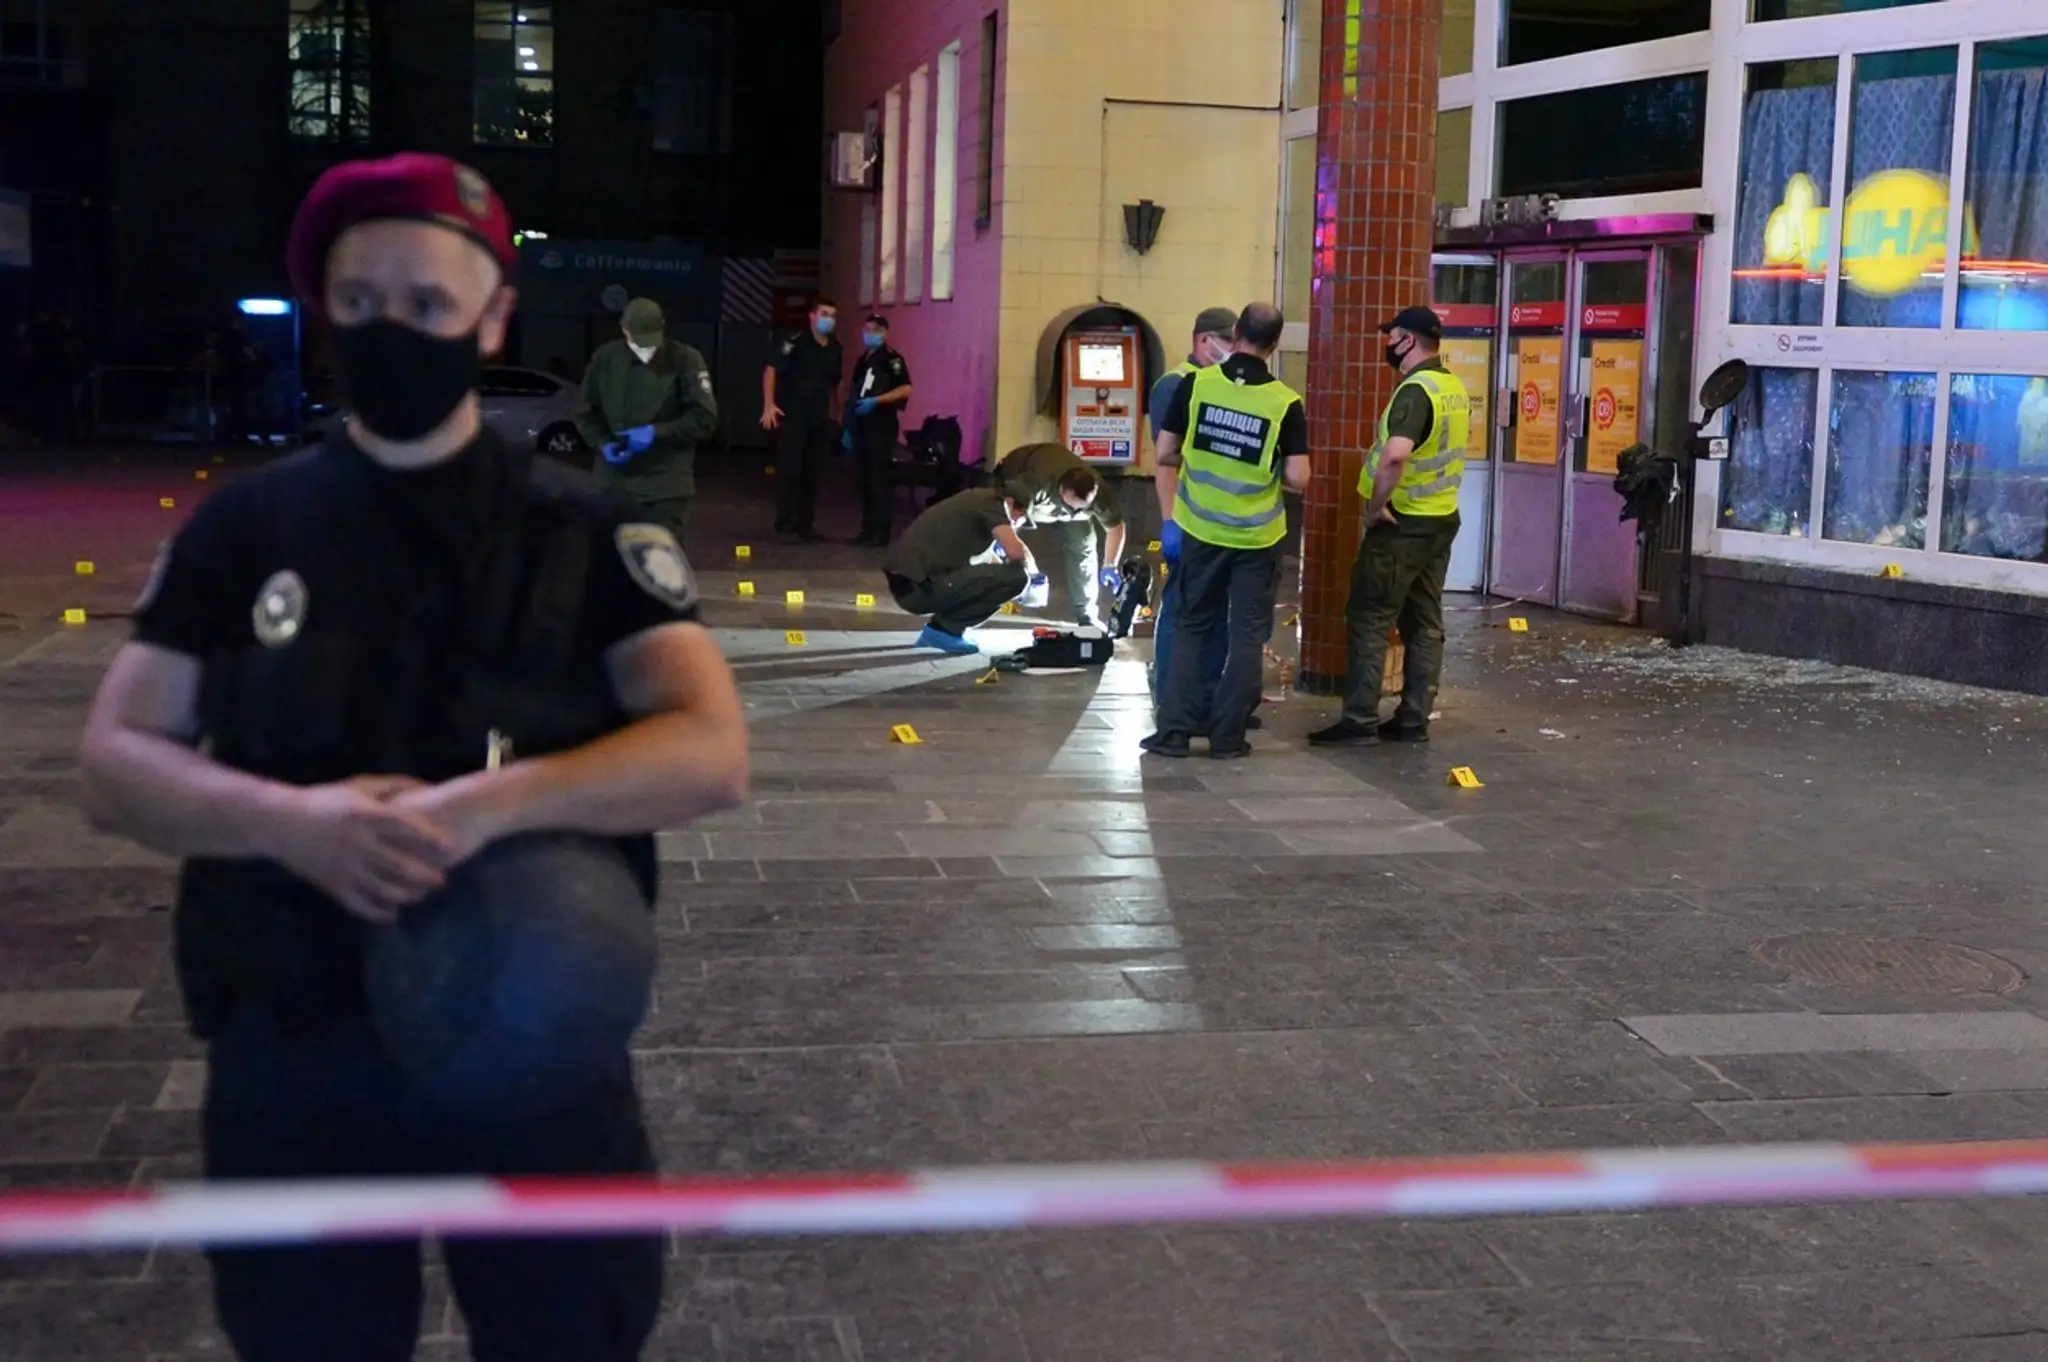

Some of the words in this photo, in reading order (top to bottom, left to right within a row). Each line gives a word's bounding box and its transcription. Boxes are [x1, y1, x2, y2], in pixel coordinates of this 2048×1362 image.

[574, 253, 692, 272] Coffeemania
[1205, 406, 1262, 434] ПОЛІЦІЯ
[788, 632, 804, 642] 10
